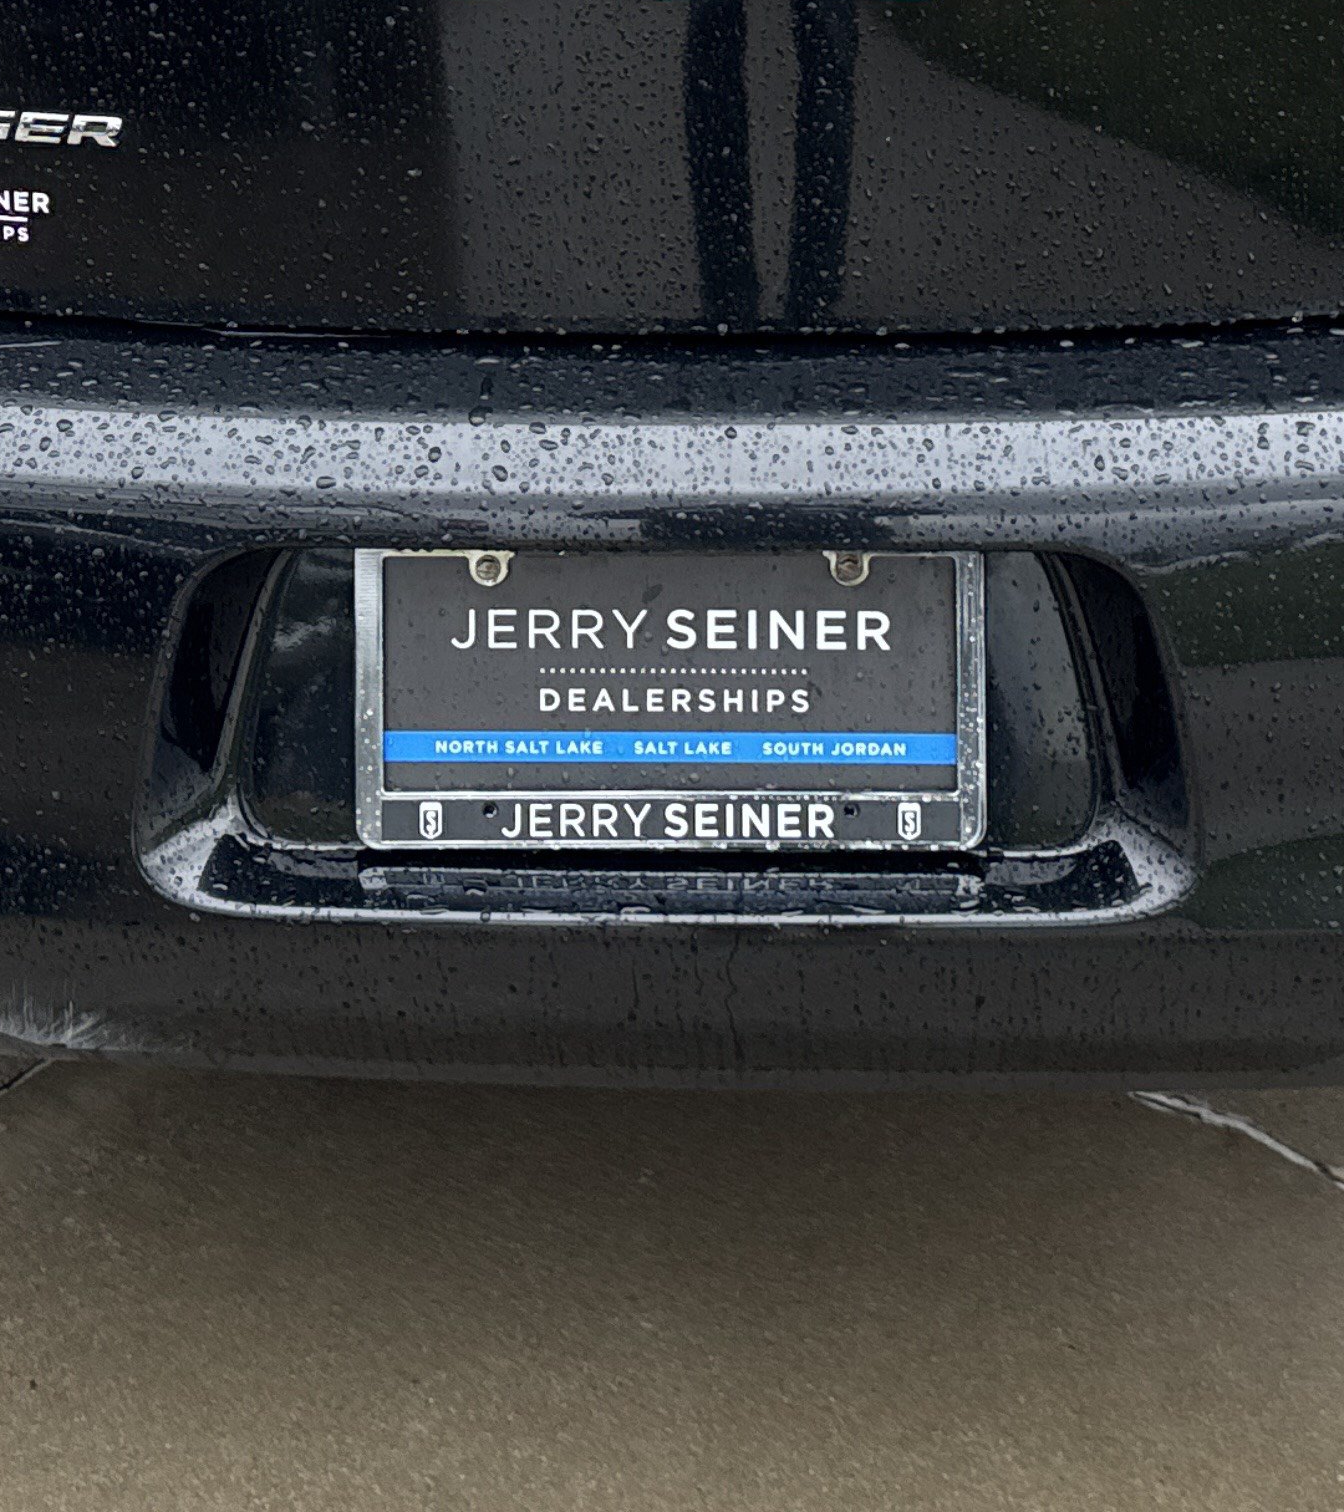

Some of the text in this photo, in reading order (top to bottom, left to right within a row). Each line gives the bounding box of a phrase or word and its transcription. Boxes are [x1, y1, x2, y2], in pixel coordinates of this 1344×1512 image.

[450, 608, 892, 652] JERRY SEINER
[539, 687, 811, 713] DEALERSHIPS
[434, 739, 908, 758] NORTH SALT LAKE SALT LAKE SOUTH JORDAN
[499, 801, 653, 839] JERRY
[663, 801, 836, 840] SEINER
